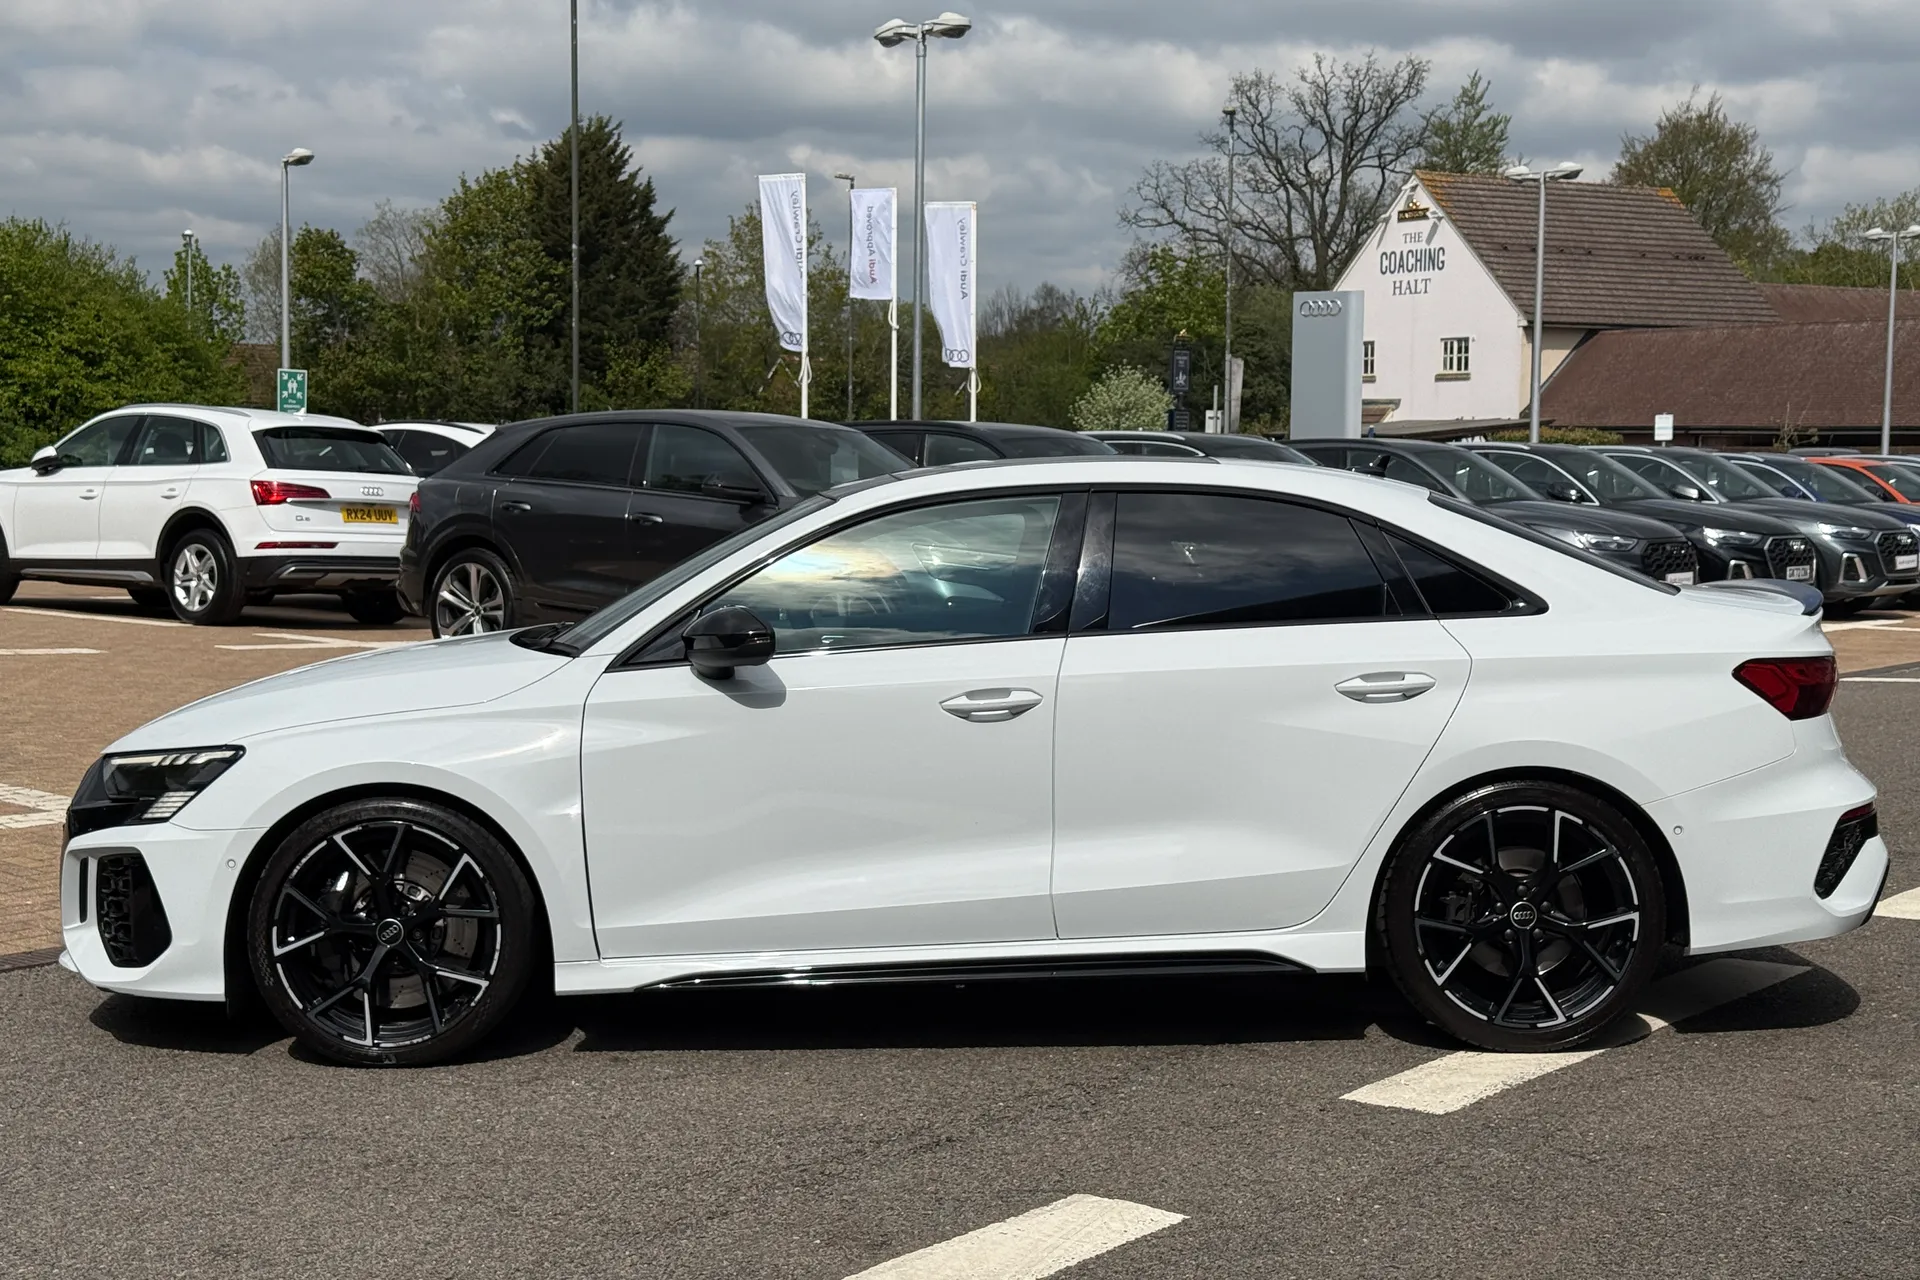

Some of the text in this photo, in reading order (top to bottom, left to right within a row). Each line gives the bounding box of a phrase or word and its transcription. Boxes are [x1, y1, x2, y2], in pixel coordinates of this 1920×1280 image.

[1402, 231, 1424, 244] THE
[1380, 247, 1445, 275] COACHING
[1392, 277, 1432, 296] HALT
[346, 508, 393, 521] RX24 UUV
